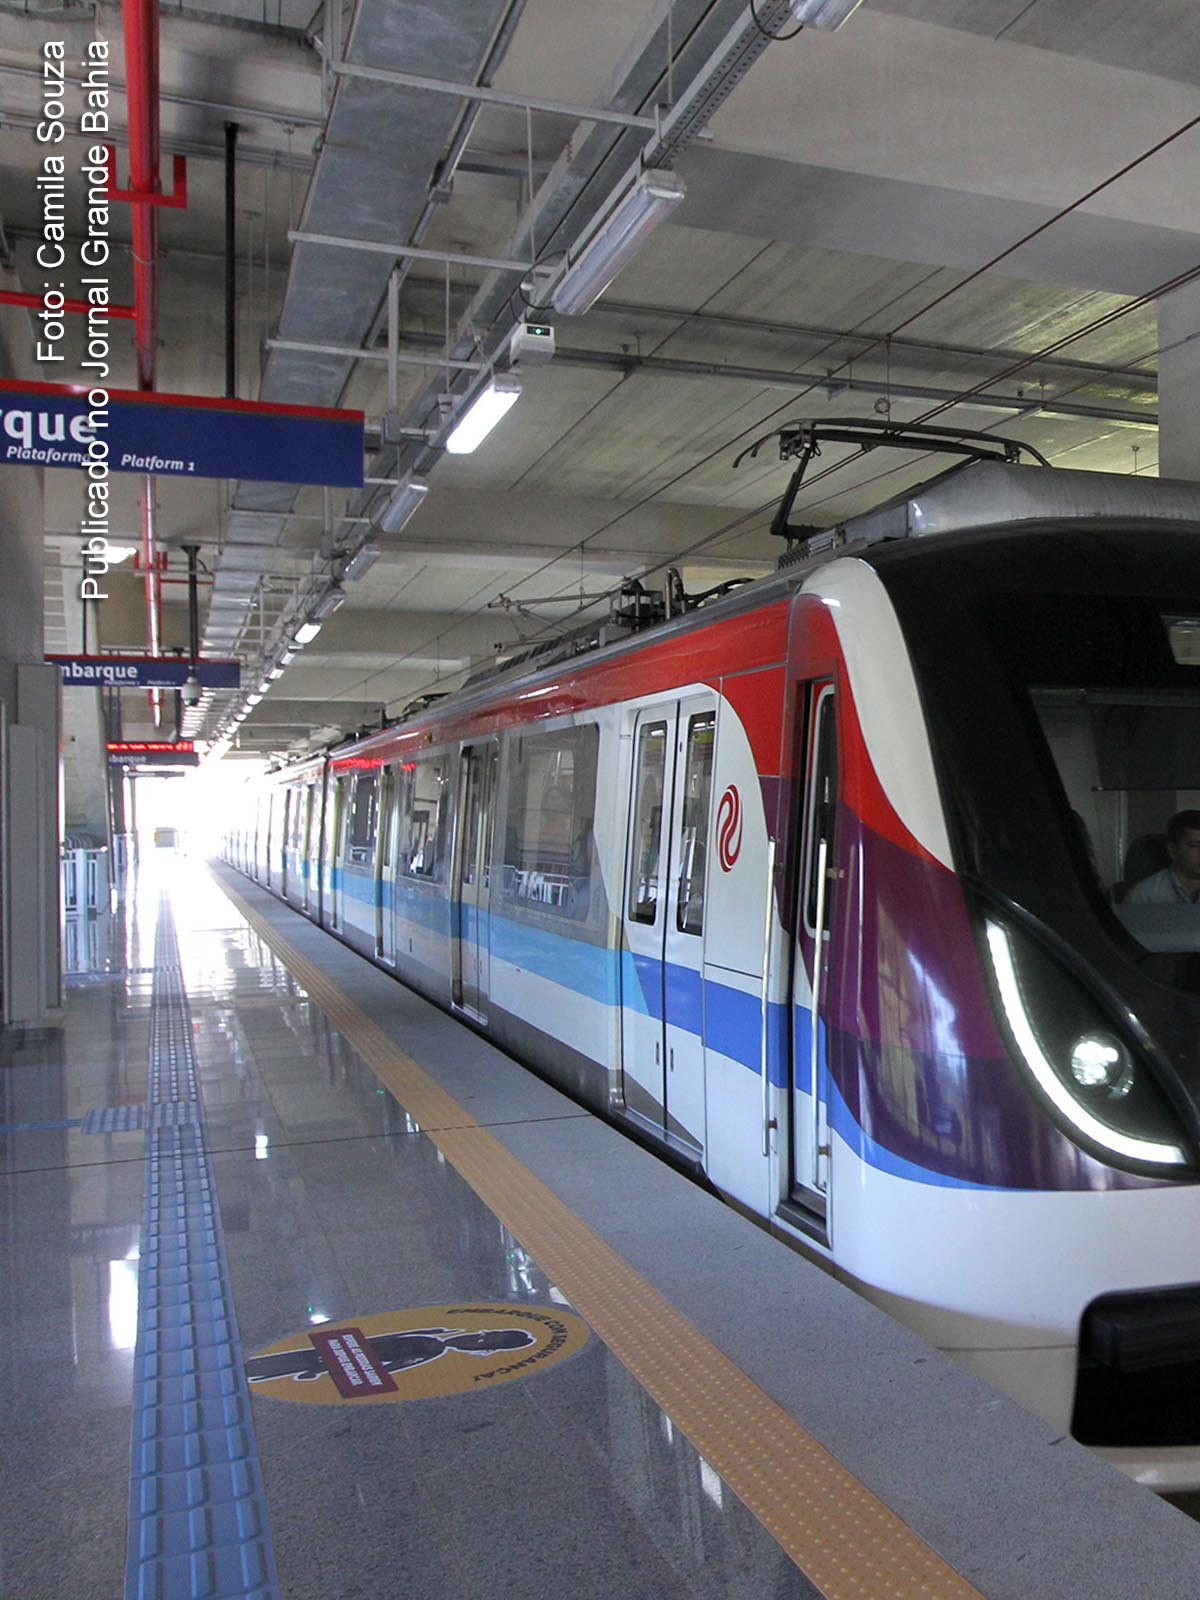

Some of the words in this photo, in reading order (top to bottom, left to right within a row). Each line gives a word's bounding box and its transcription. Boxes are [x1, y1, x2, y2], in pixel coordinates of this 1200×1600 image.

[0, 408, 98, 448] que
[121, 453, 184, 471] Platform
[188, 462, 195, 471] 1
